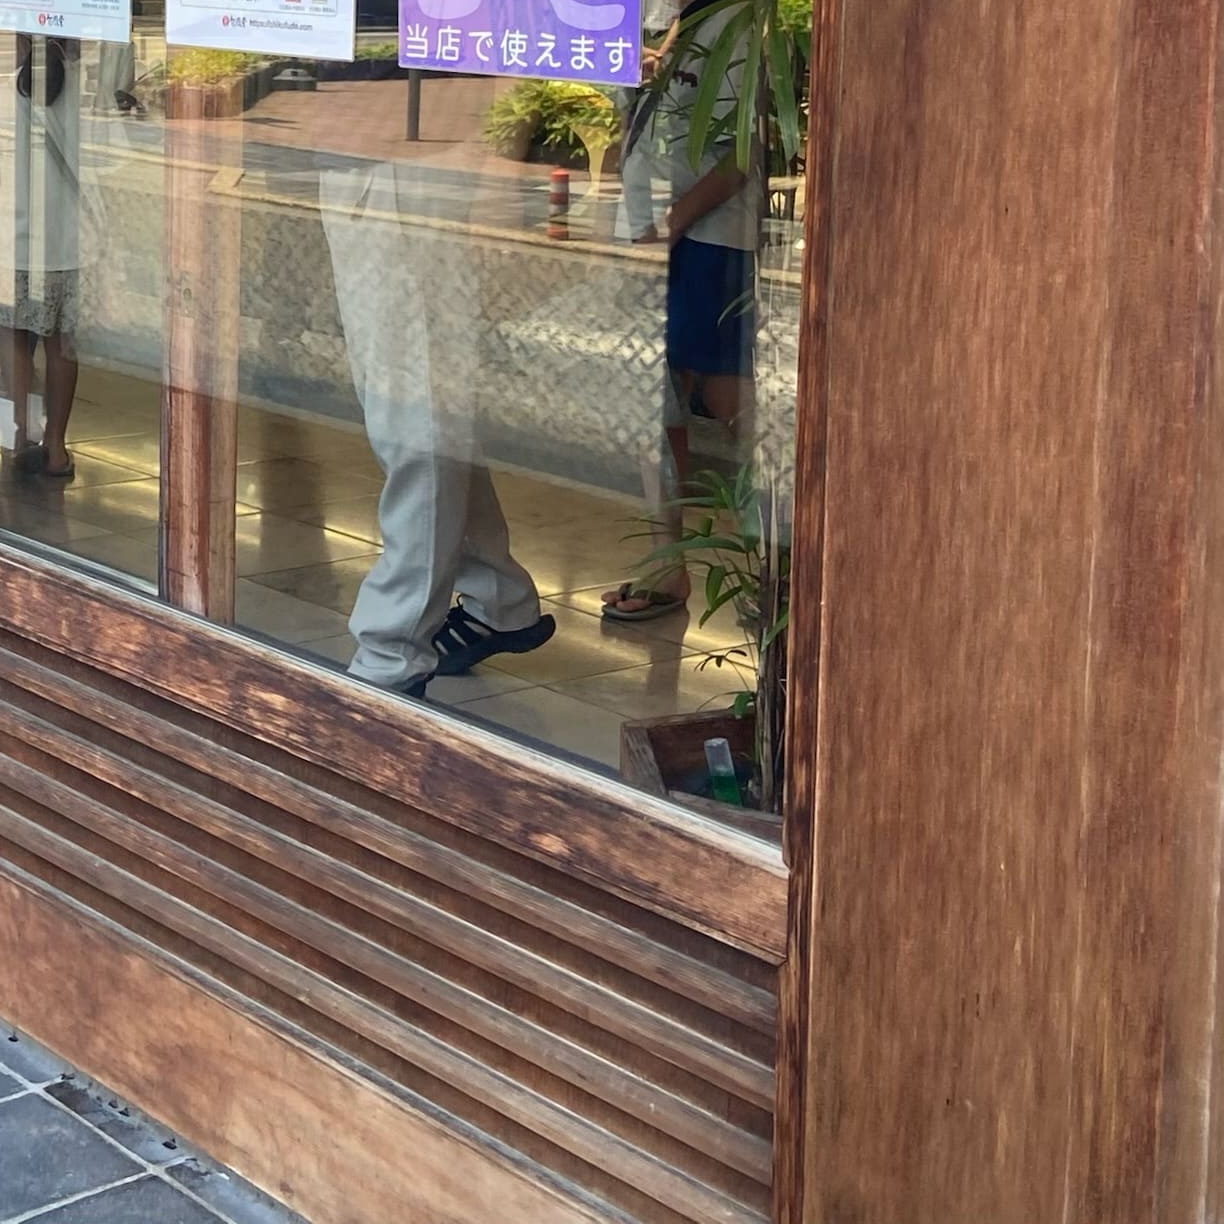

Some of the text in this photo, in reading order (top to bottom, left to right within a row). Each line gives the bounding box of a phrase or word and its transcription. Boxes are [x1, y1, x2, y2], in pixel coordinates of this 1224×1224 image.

[405, 24, 633, 74] 当店で使えます
